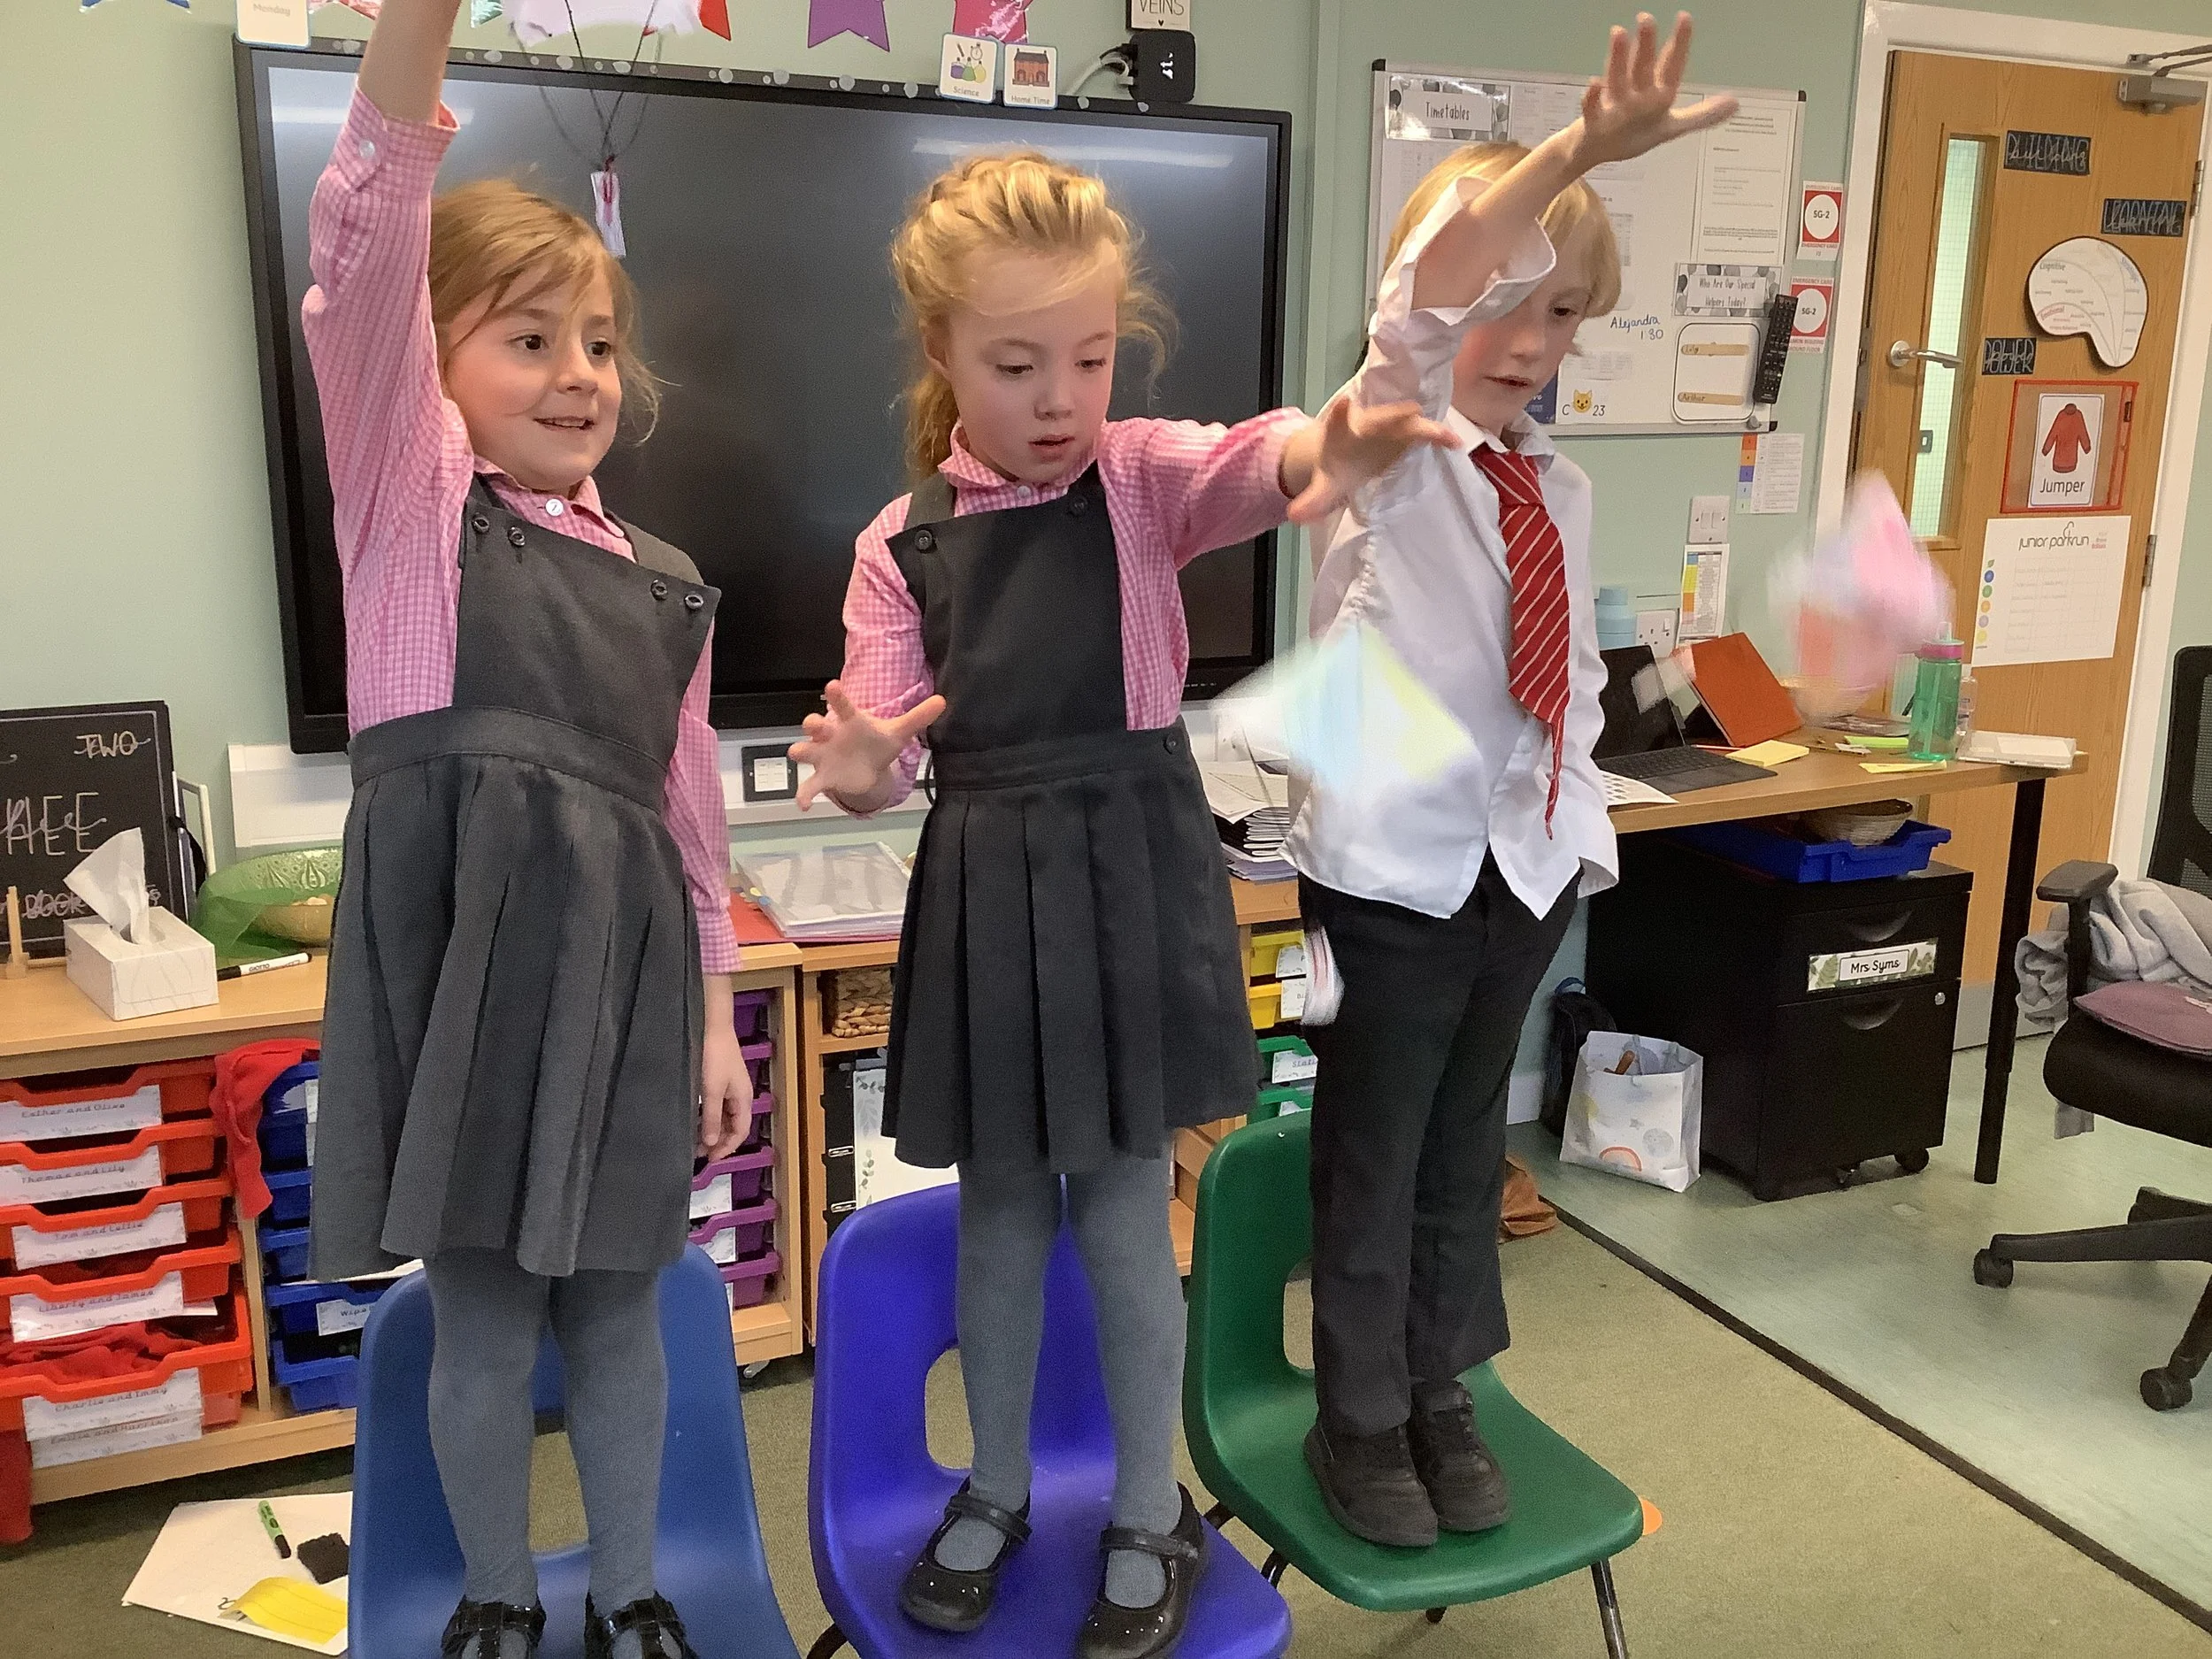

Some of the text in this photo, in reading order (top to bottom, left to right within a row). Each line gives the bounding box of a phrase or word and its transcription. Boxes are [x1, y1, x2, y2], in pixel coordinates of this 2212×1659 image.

[253, 4, 290, 17] Monday
[1140, 0, 1184, 15] VEINS
[953, 86, 979, 96] Science
[1425, 101, 1470, 120] Timetables
[1699, 278, 1710, 288] Who
[1713, 279, 1723, 288] Are
[1737, 279, 1755, 290] Special
[1705, 296, 1724, 307] Helpers
[1610, 314, 1660, 333] Alejandra
[1562, 404, 1606, 416] C 23
[2039, 478, 2085, 496] Jumper
[2018, 521, 2089, 550] junior parkrun
[249, 964, 270, 972] GIOTTO
[1850, 959, 1901, 974] Mrs Syms
[21, 1102, 126, 1118] Esther and Olive
[22, 1164, 126, 1184] Thomas and Lily
[82, 1226, 107, 1237] and
[39, 1302, 86, 1313] Liberty
[88, 1295, 112, 1306] and
[55, 1397, 104, 1413] Charlie
[109, 1391, 133, 1402] and
[95, 1425, 118, 1436] and
